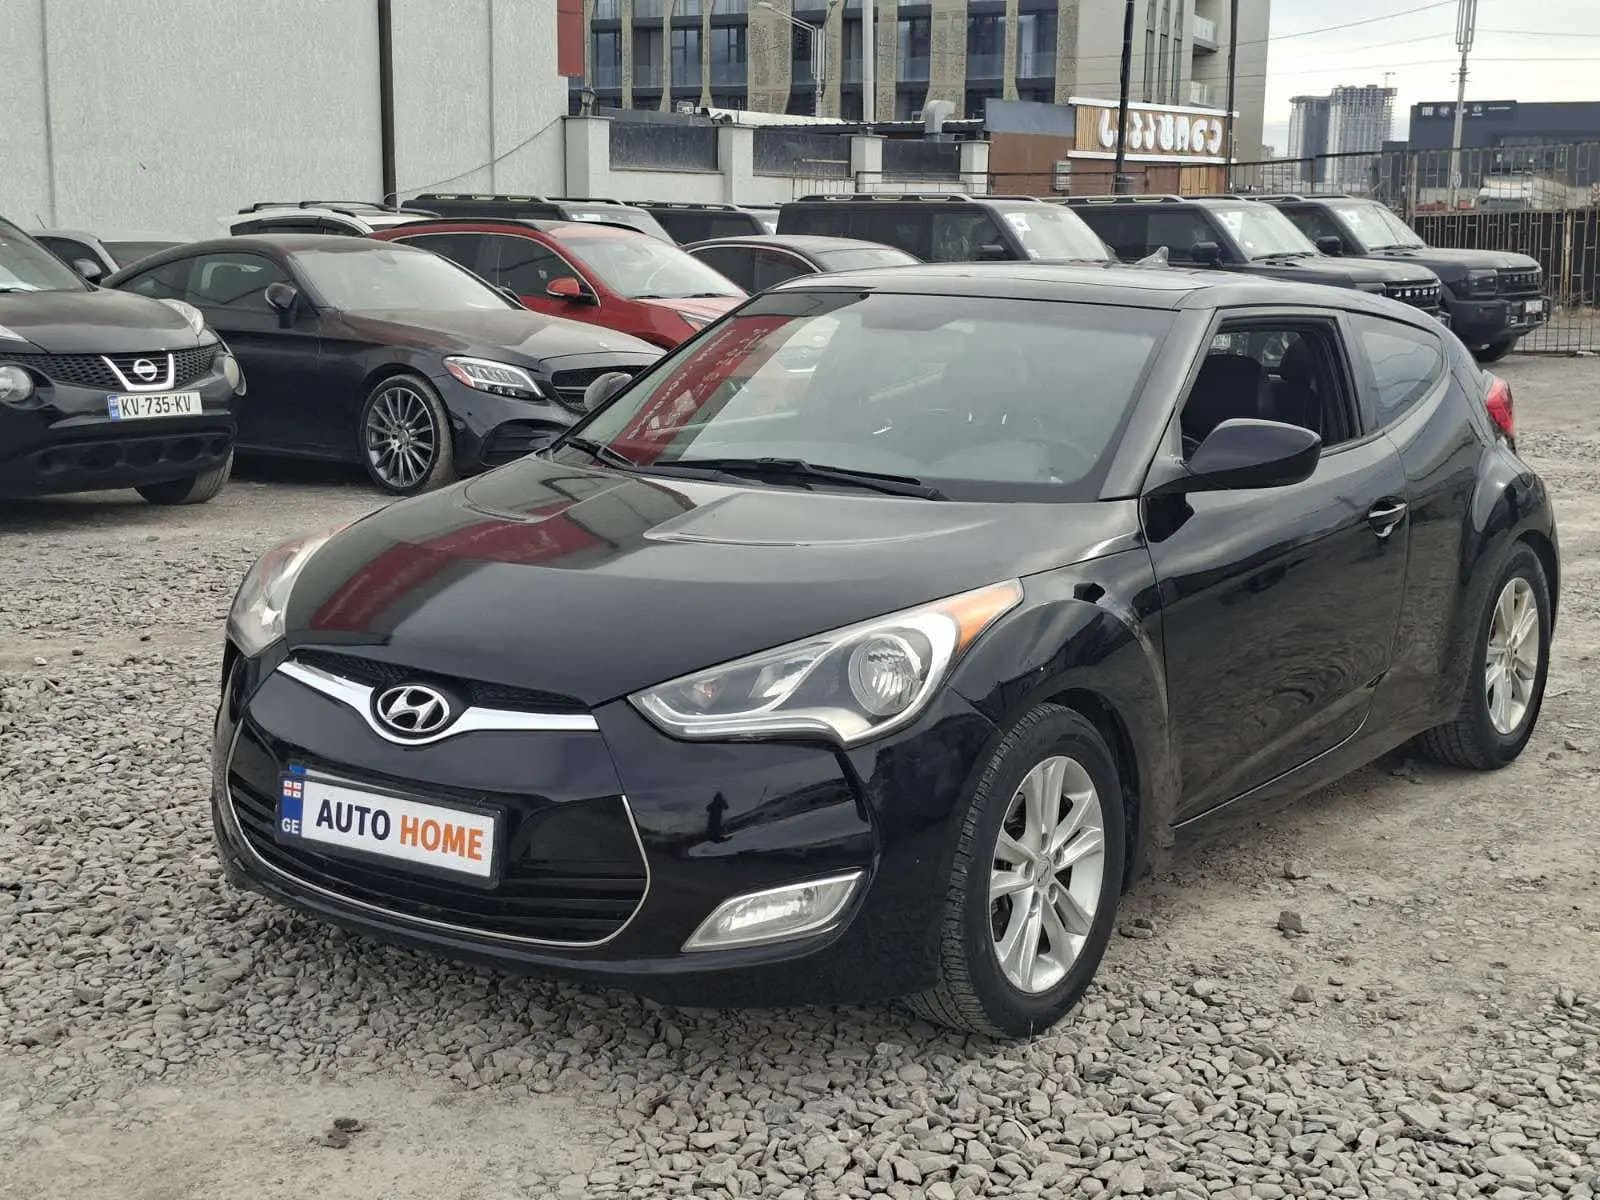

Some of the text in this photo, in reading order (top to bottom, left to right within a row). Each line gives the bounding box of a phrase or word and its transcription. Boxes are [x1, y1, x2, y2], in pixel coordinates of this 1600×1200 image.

[121, 394, 191, 416] KV-735-KV
[281, 818, 300, 835] GE
[315, 798, 484, 861] AUTO HOME
